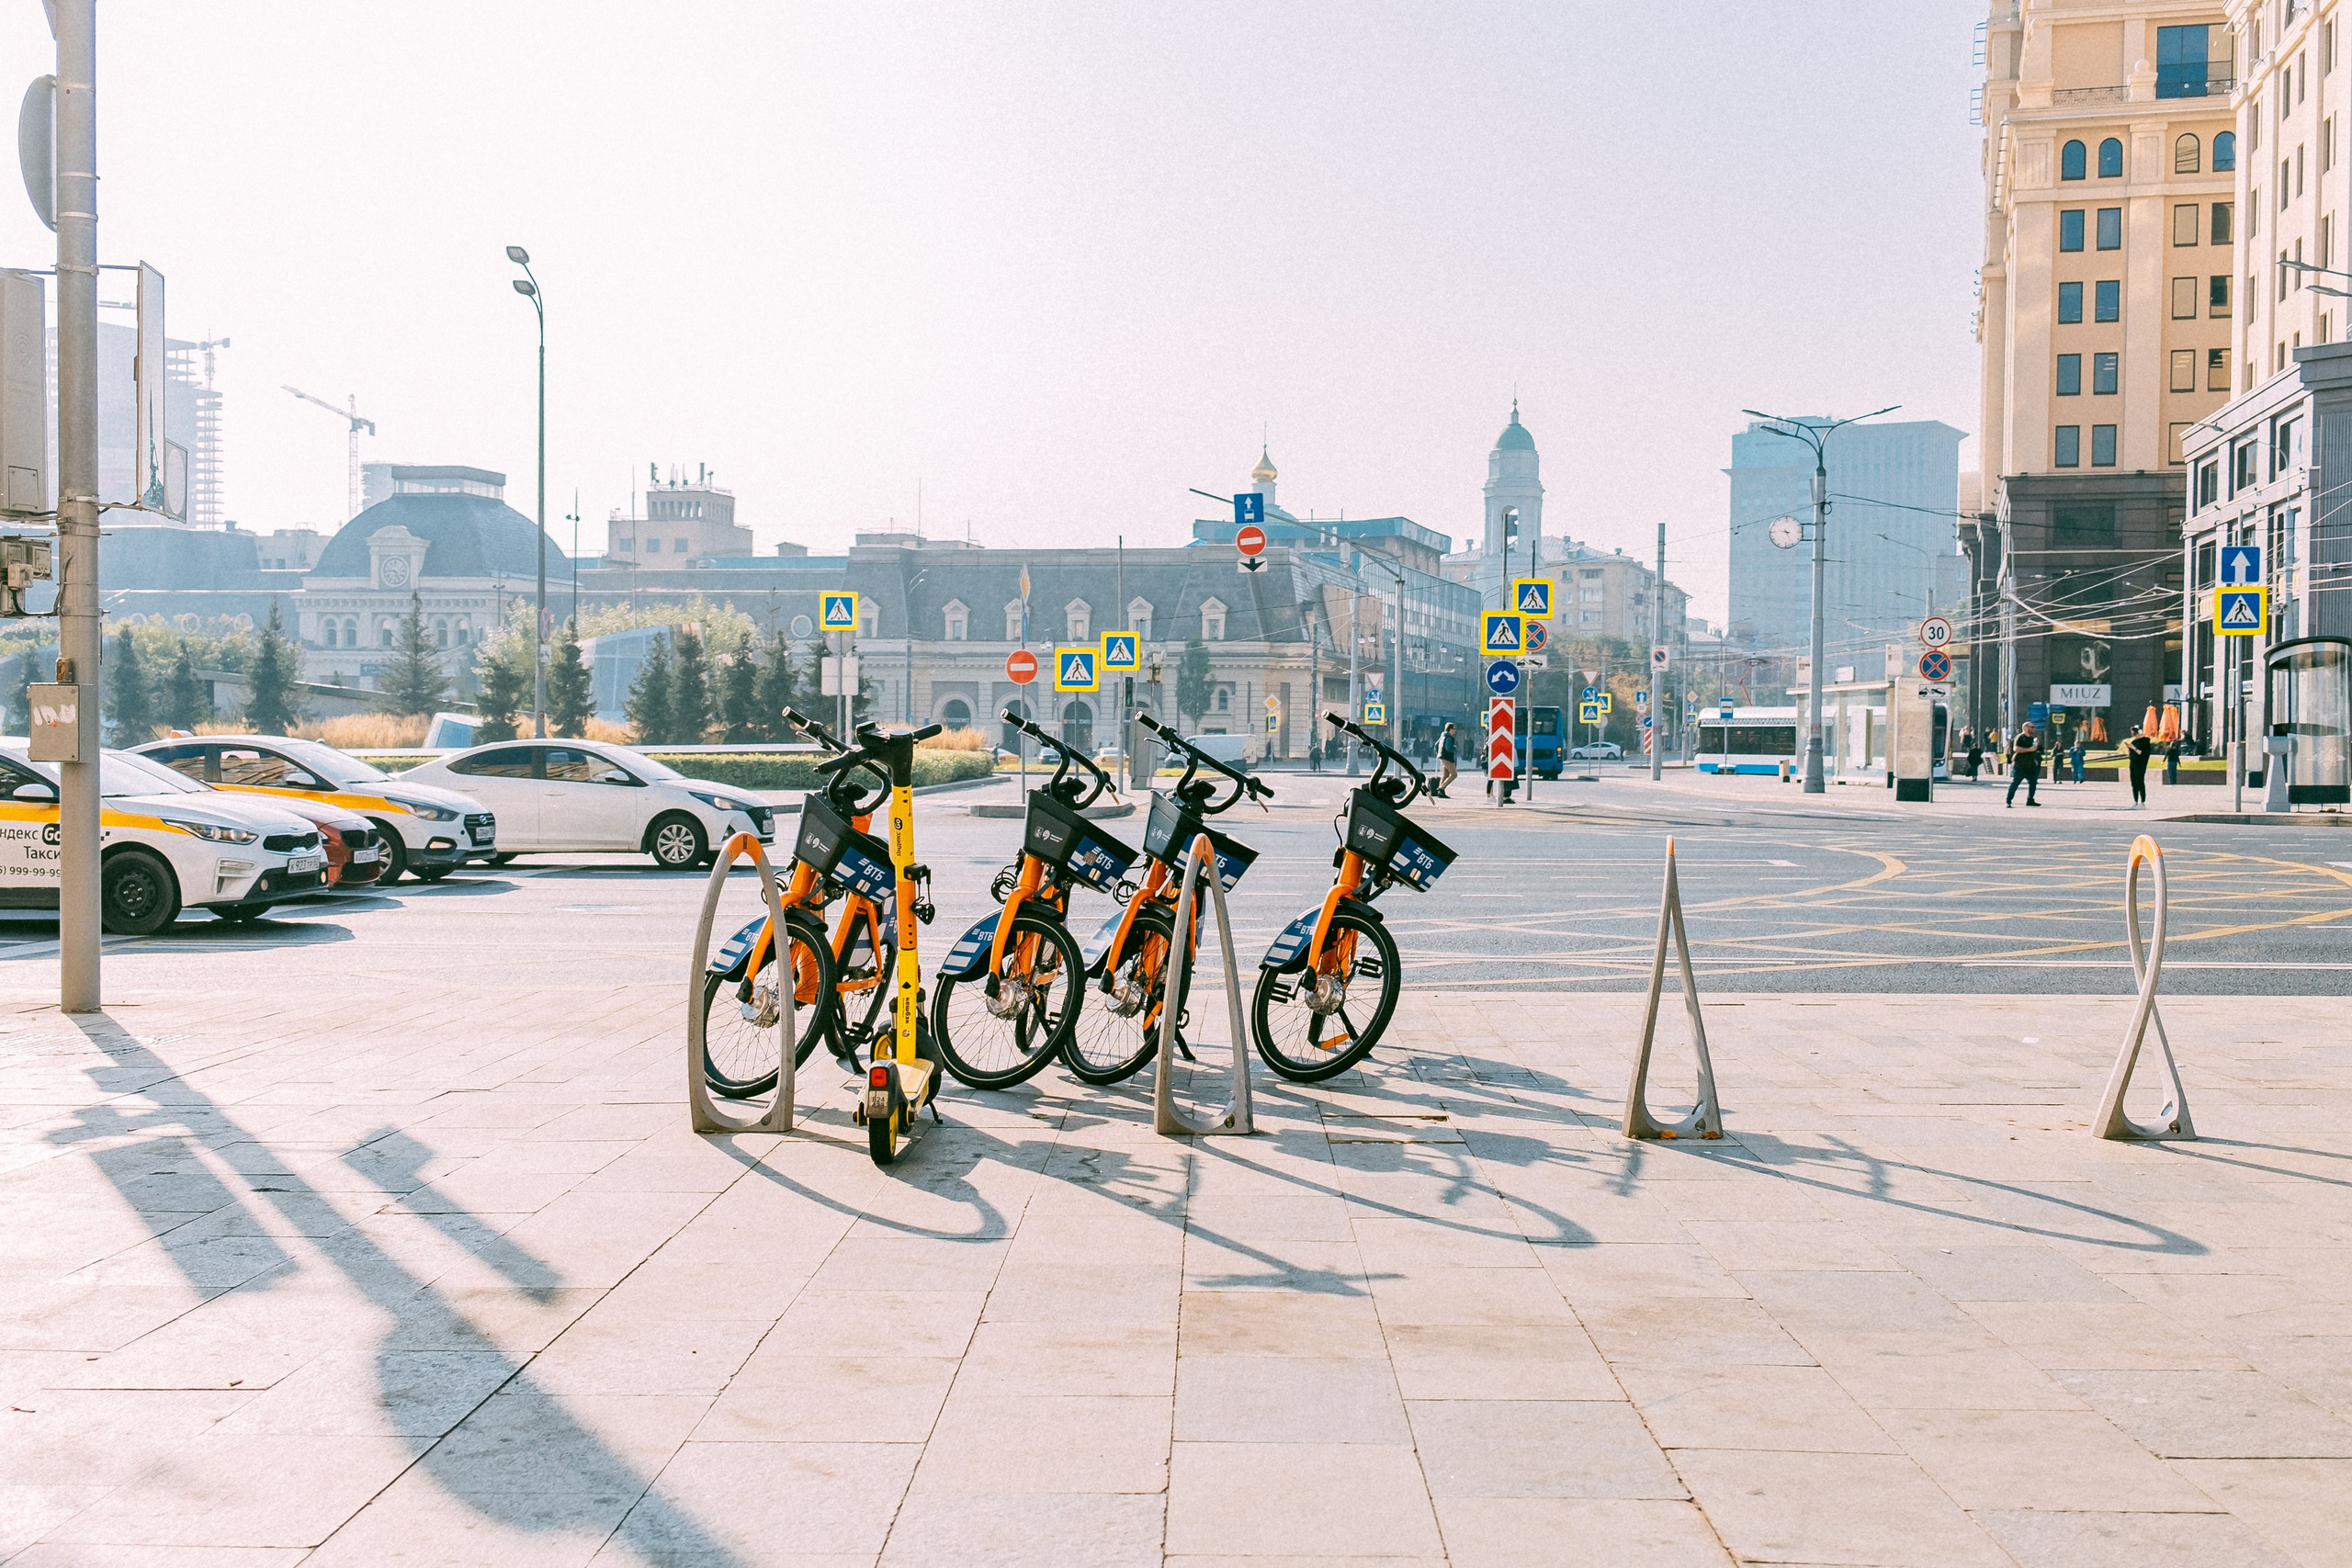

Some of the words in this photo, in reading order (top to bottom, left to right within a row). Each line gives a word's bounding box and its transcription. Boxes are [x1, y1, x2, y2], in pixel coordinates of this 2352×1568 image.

[1928, 626, 1945, 640] 30
[2060, 687, 2101, 699] MIUZ
[0, 828, 39, 840] ндекс
[23, 845, 61, 860] Такси
[1095, 852, 1114, 870] ВТБ
[1216, 853, 1227, 868] ТБ
[1417, 852, 1434, 870] ВТБ
[9, 866, 61, 877] 999-99-99
[864, 863, 886, 881] ВТБ
[978, 931, 994, 942] ВТБ
